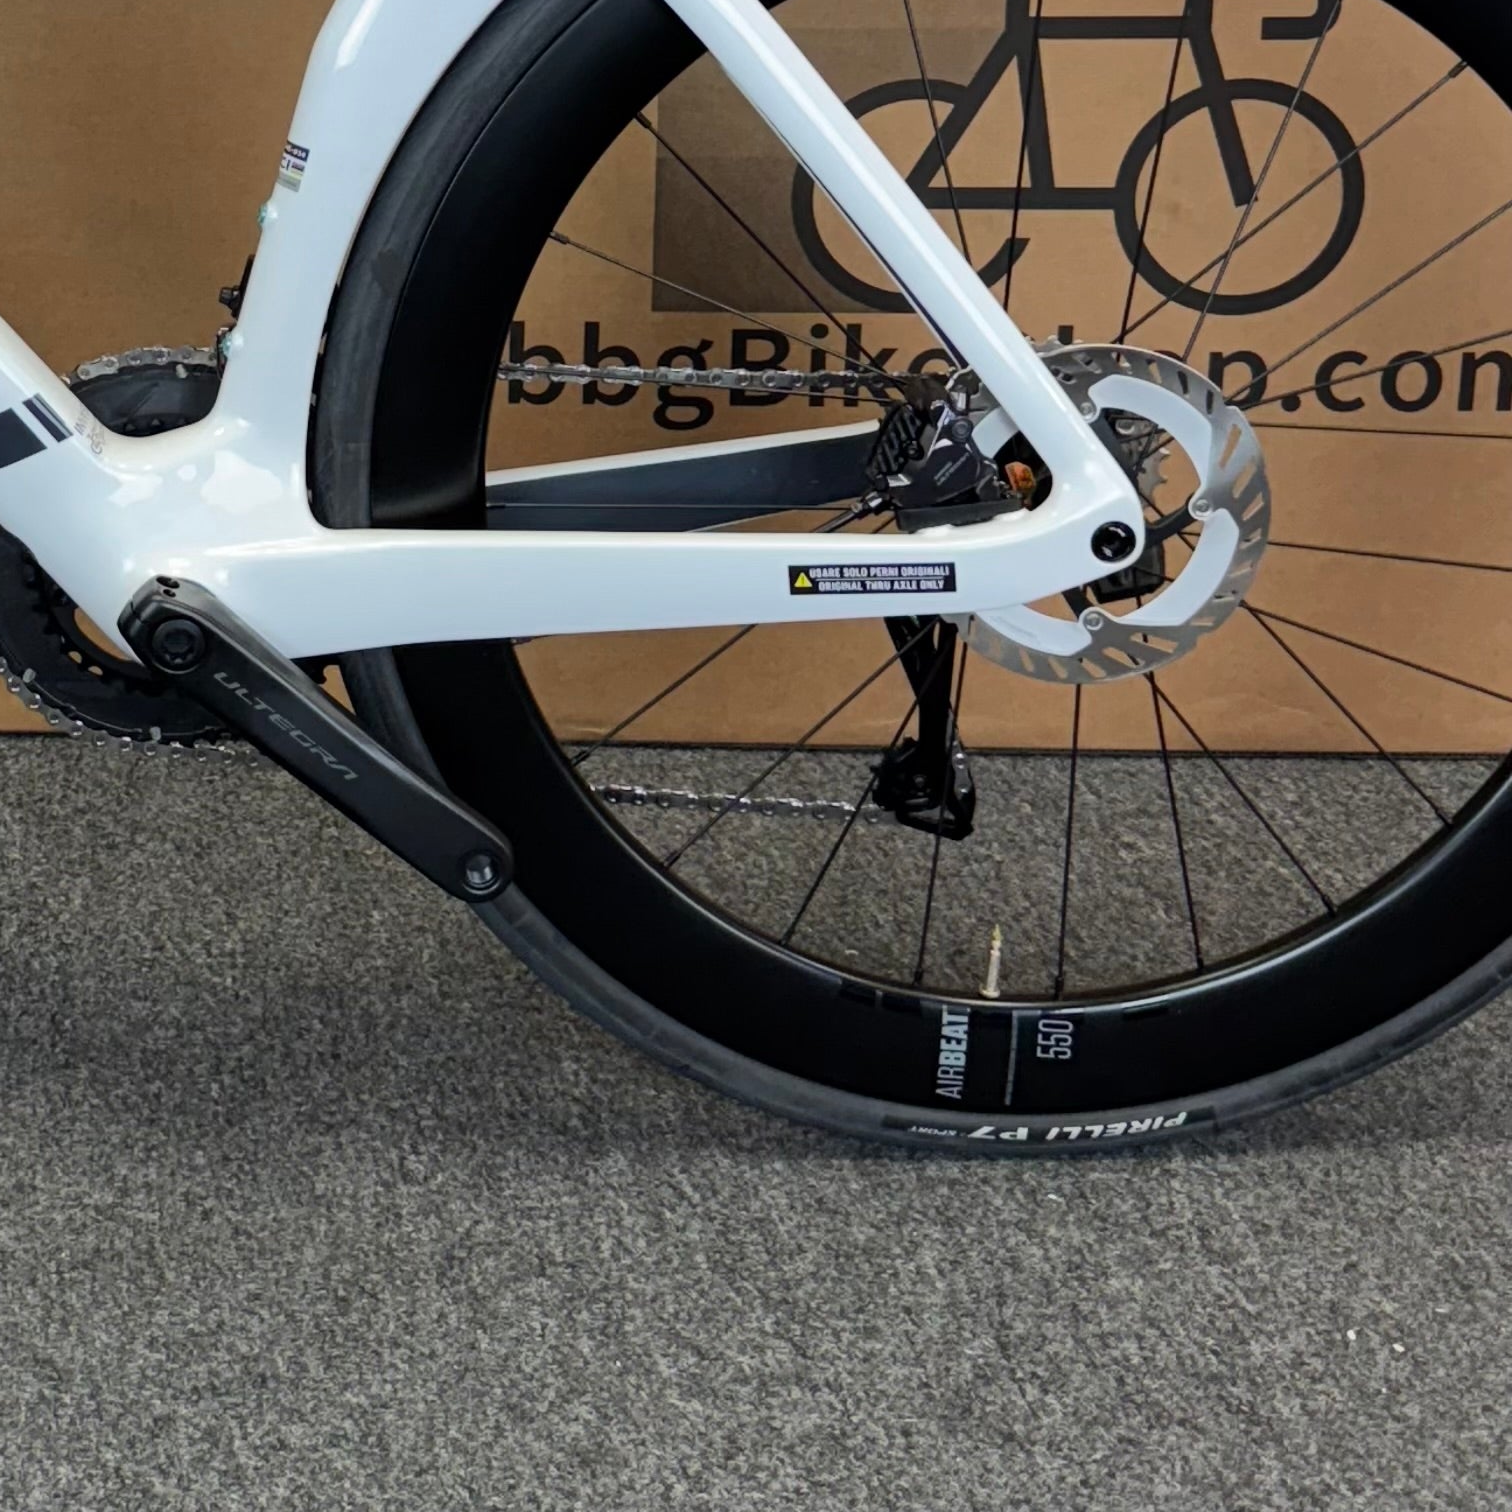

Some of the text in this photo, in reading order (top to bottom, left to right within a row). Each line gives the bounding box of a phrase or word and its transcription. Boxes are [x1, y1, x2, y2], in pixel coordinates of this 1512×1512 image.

[809, 566, 950, 578] USARE SOLO PERNI ORIGINALI
[818, 579, 945, 592] ORIGINAL THRU AXLE ONLY
[214, 672, 359, 781] ULTEGRA
[935, 1004, 1074, 1100] AIRBEAT 550
[968, 1125, 1029, 1141] P7
[1045, 1111, 1188, 1141] PIRELLI
